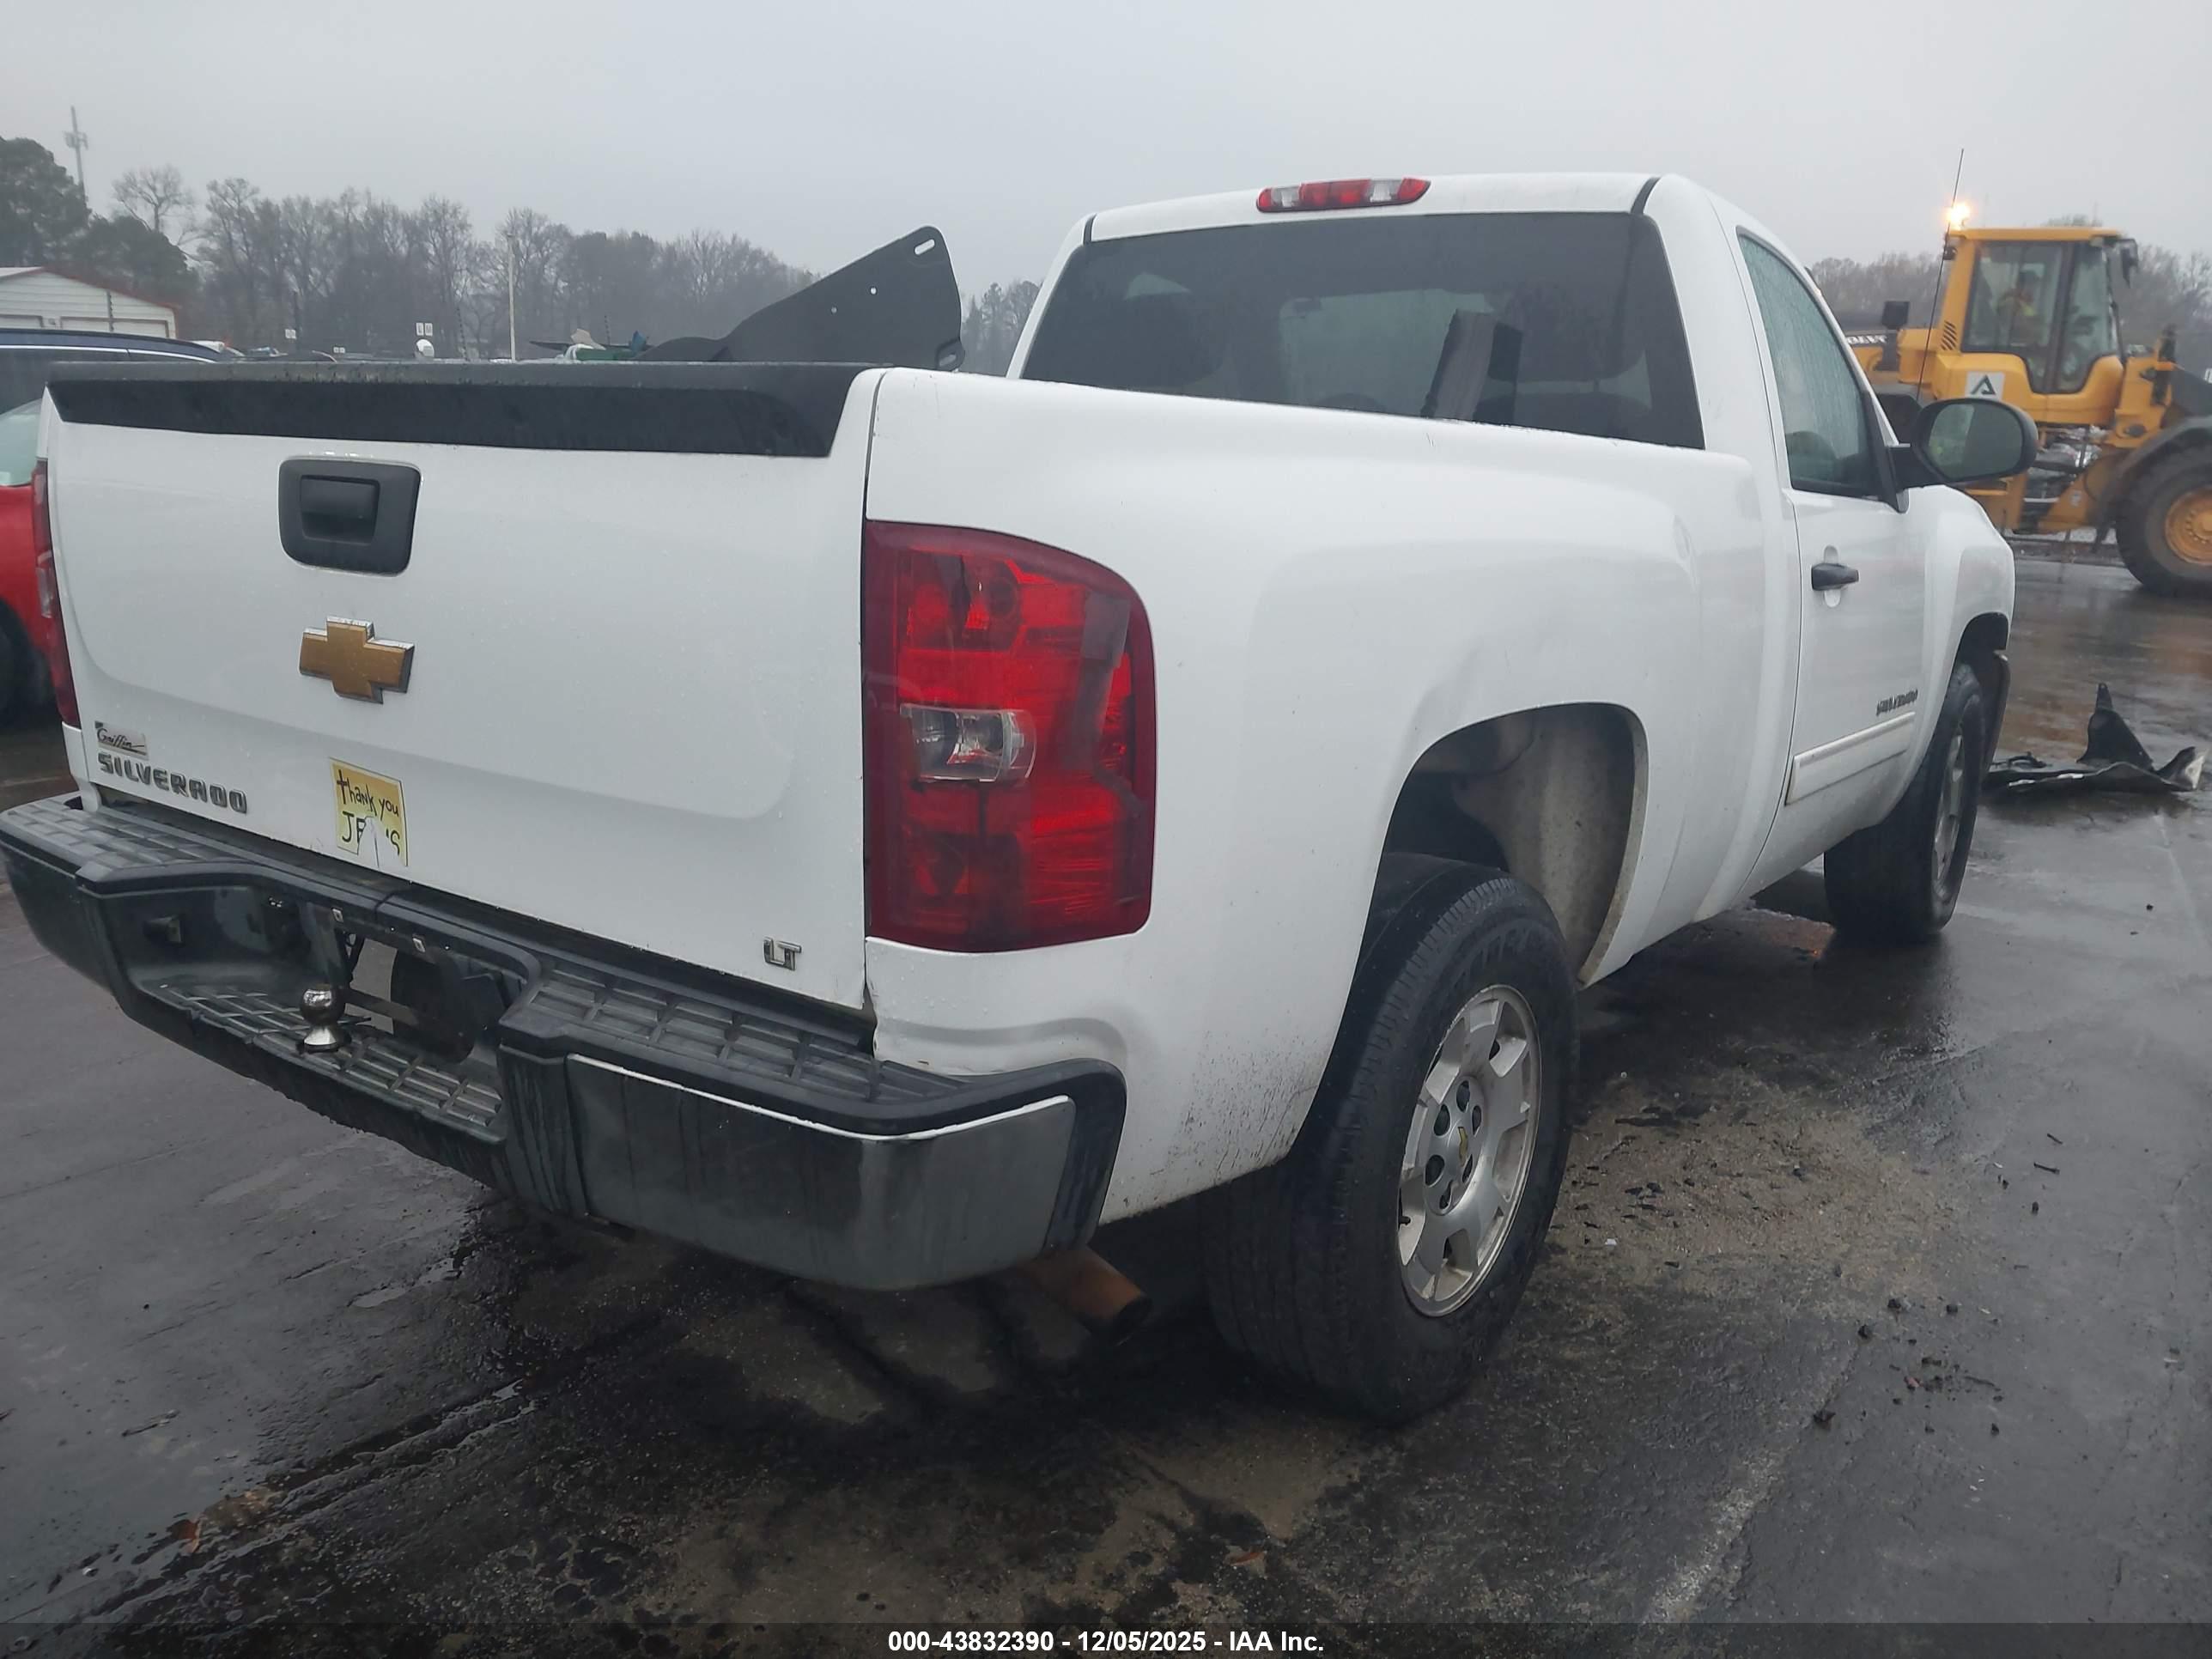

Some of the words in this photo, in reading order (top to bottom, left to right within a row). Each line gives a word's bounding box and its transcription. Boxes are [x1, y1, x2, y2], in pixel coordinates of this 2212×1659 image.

[98, 752, 247, 814] SILVERADO
[379, 798, 399, 822] you
[763, 935, 802, 971] LT
